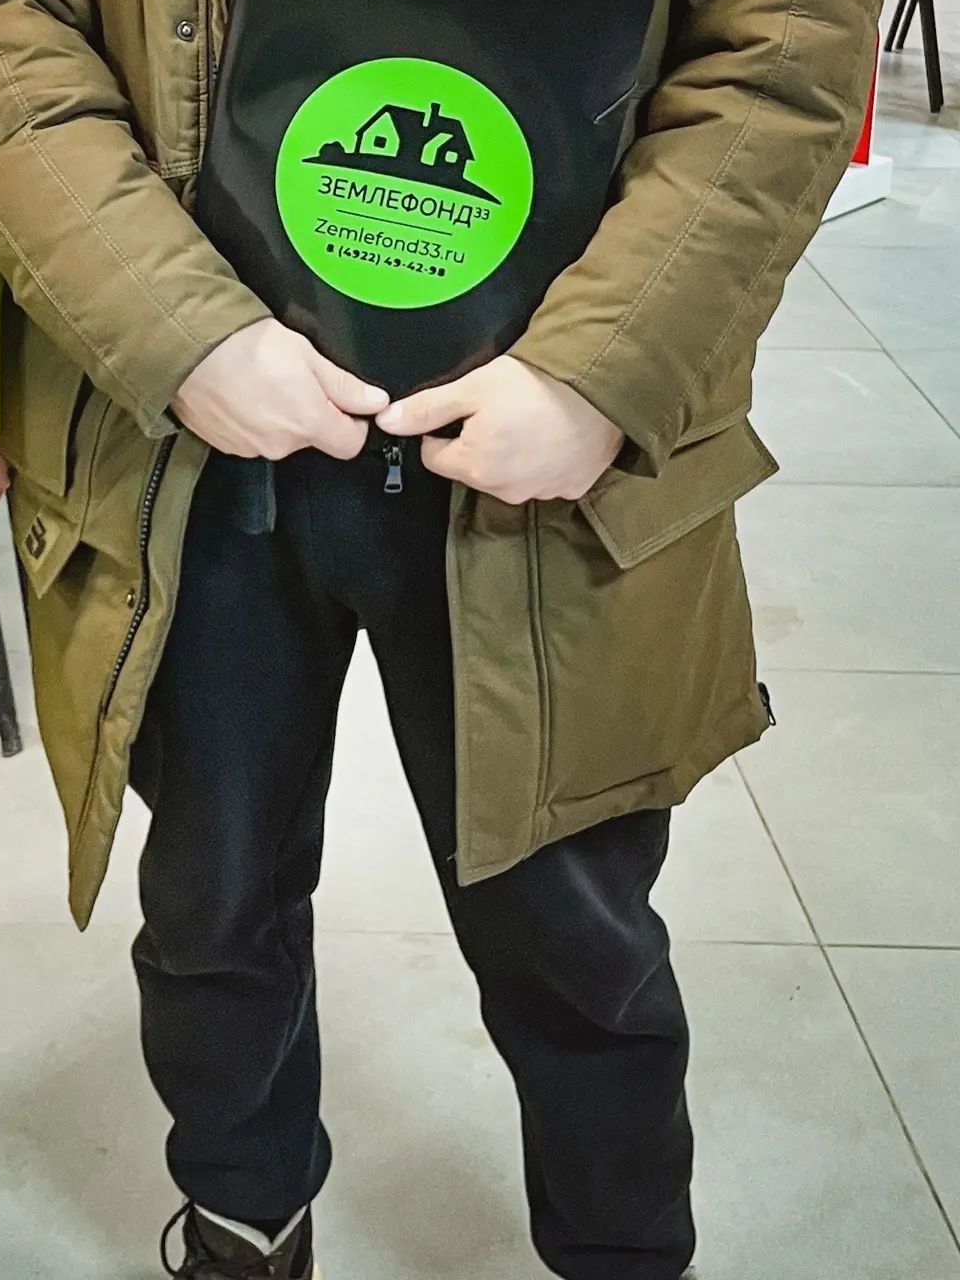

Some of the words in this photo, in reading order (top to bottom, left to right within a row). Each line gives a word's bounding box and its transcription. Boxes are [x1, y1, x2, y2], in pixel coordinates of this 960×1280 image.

[314, 218, 465, 264] Zemlefond33.ru
[338, 245, 381, 266] (4922)
[384, 256, 446, 277] 49-42-98
